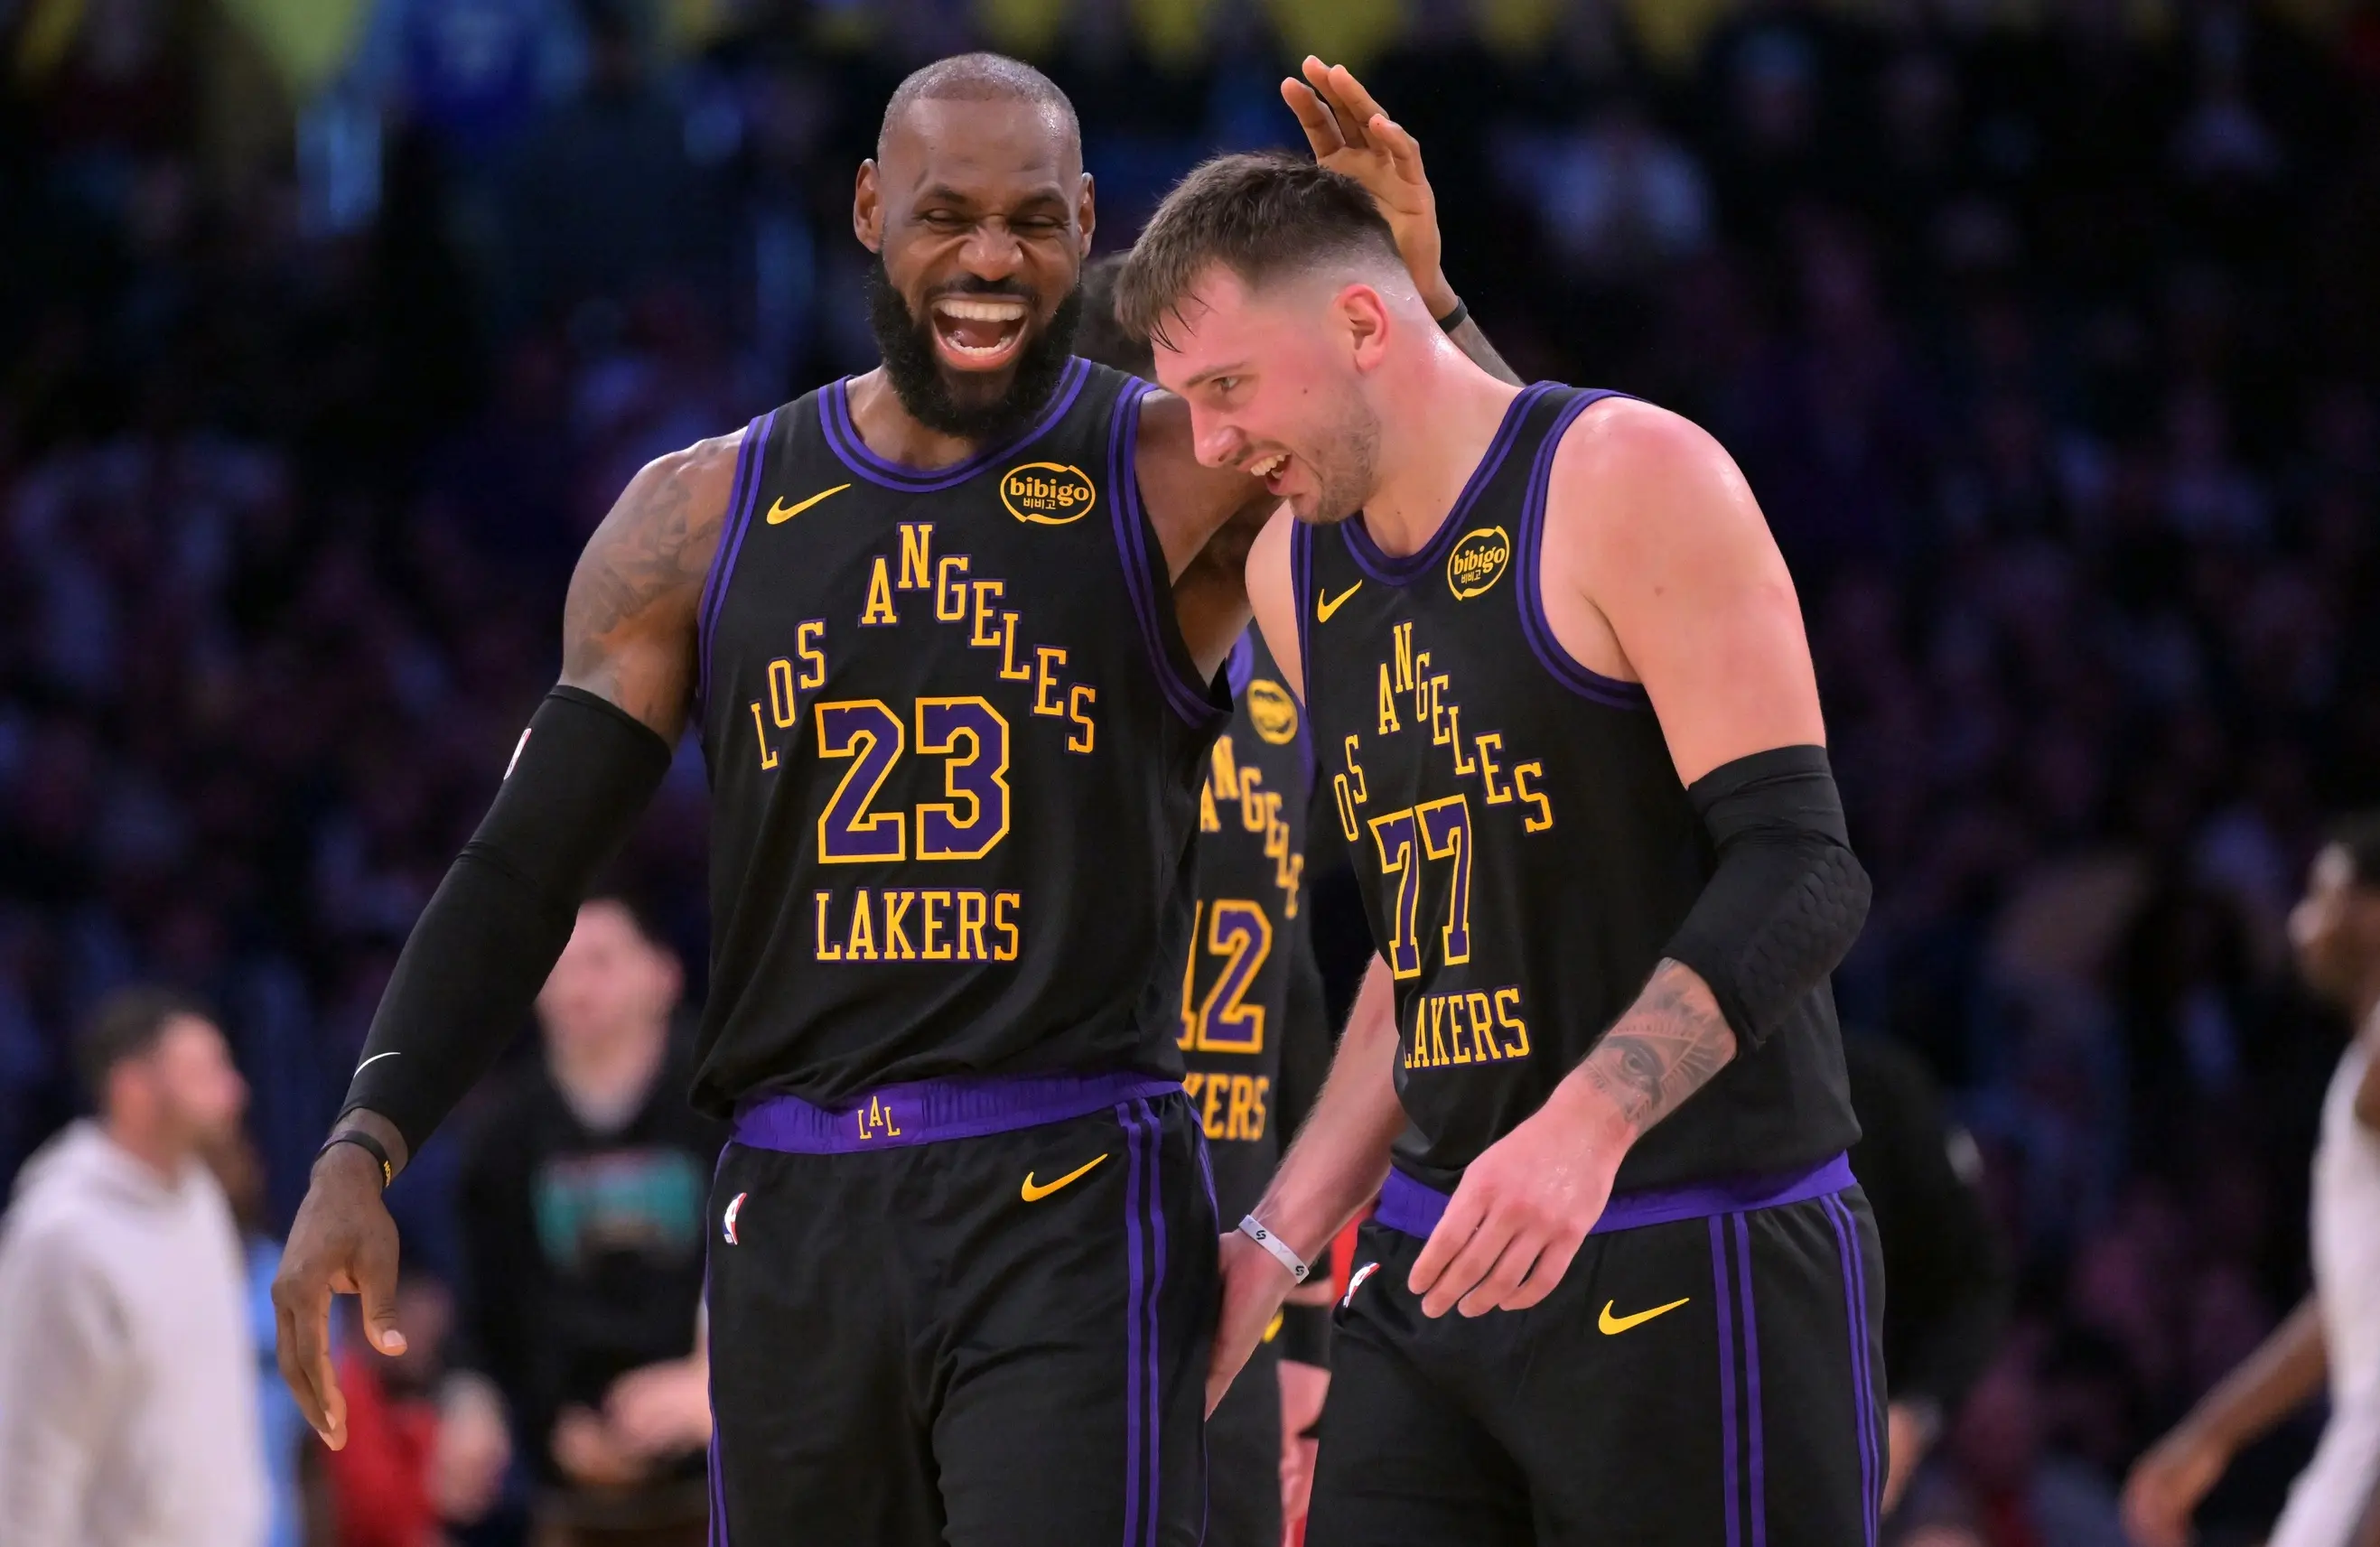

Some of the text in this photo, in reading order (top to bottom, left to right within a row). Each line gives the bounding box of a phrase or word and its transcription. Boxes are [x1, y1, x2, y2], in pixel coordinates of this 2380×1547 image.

[1010, 477, 1089, 507] bibigo
[1022, 498, 1056, 509] 비비고
[1453, 545, 1506, 575] bibigo
[1461, 569, 1481, 583] 비비고
[750, 524, 1097, 769] LOS ANGELES
[1378, 621, 1554, 834] ANGELES
[815, 695, 1010, 864] 23
[1367, 793, 1472, 981] 77
[816, 890, 1021, 961] LAKERS
[857, 1095, 901, 1140] LAL
